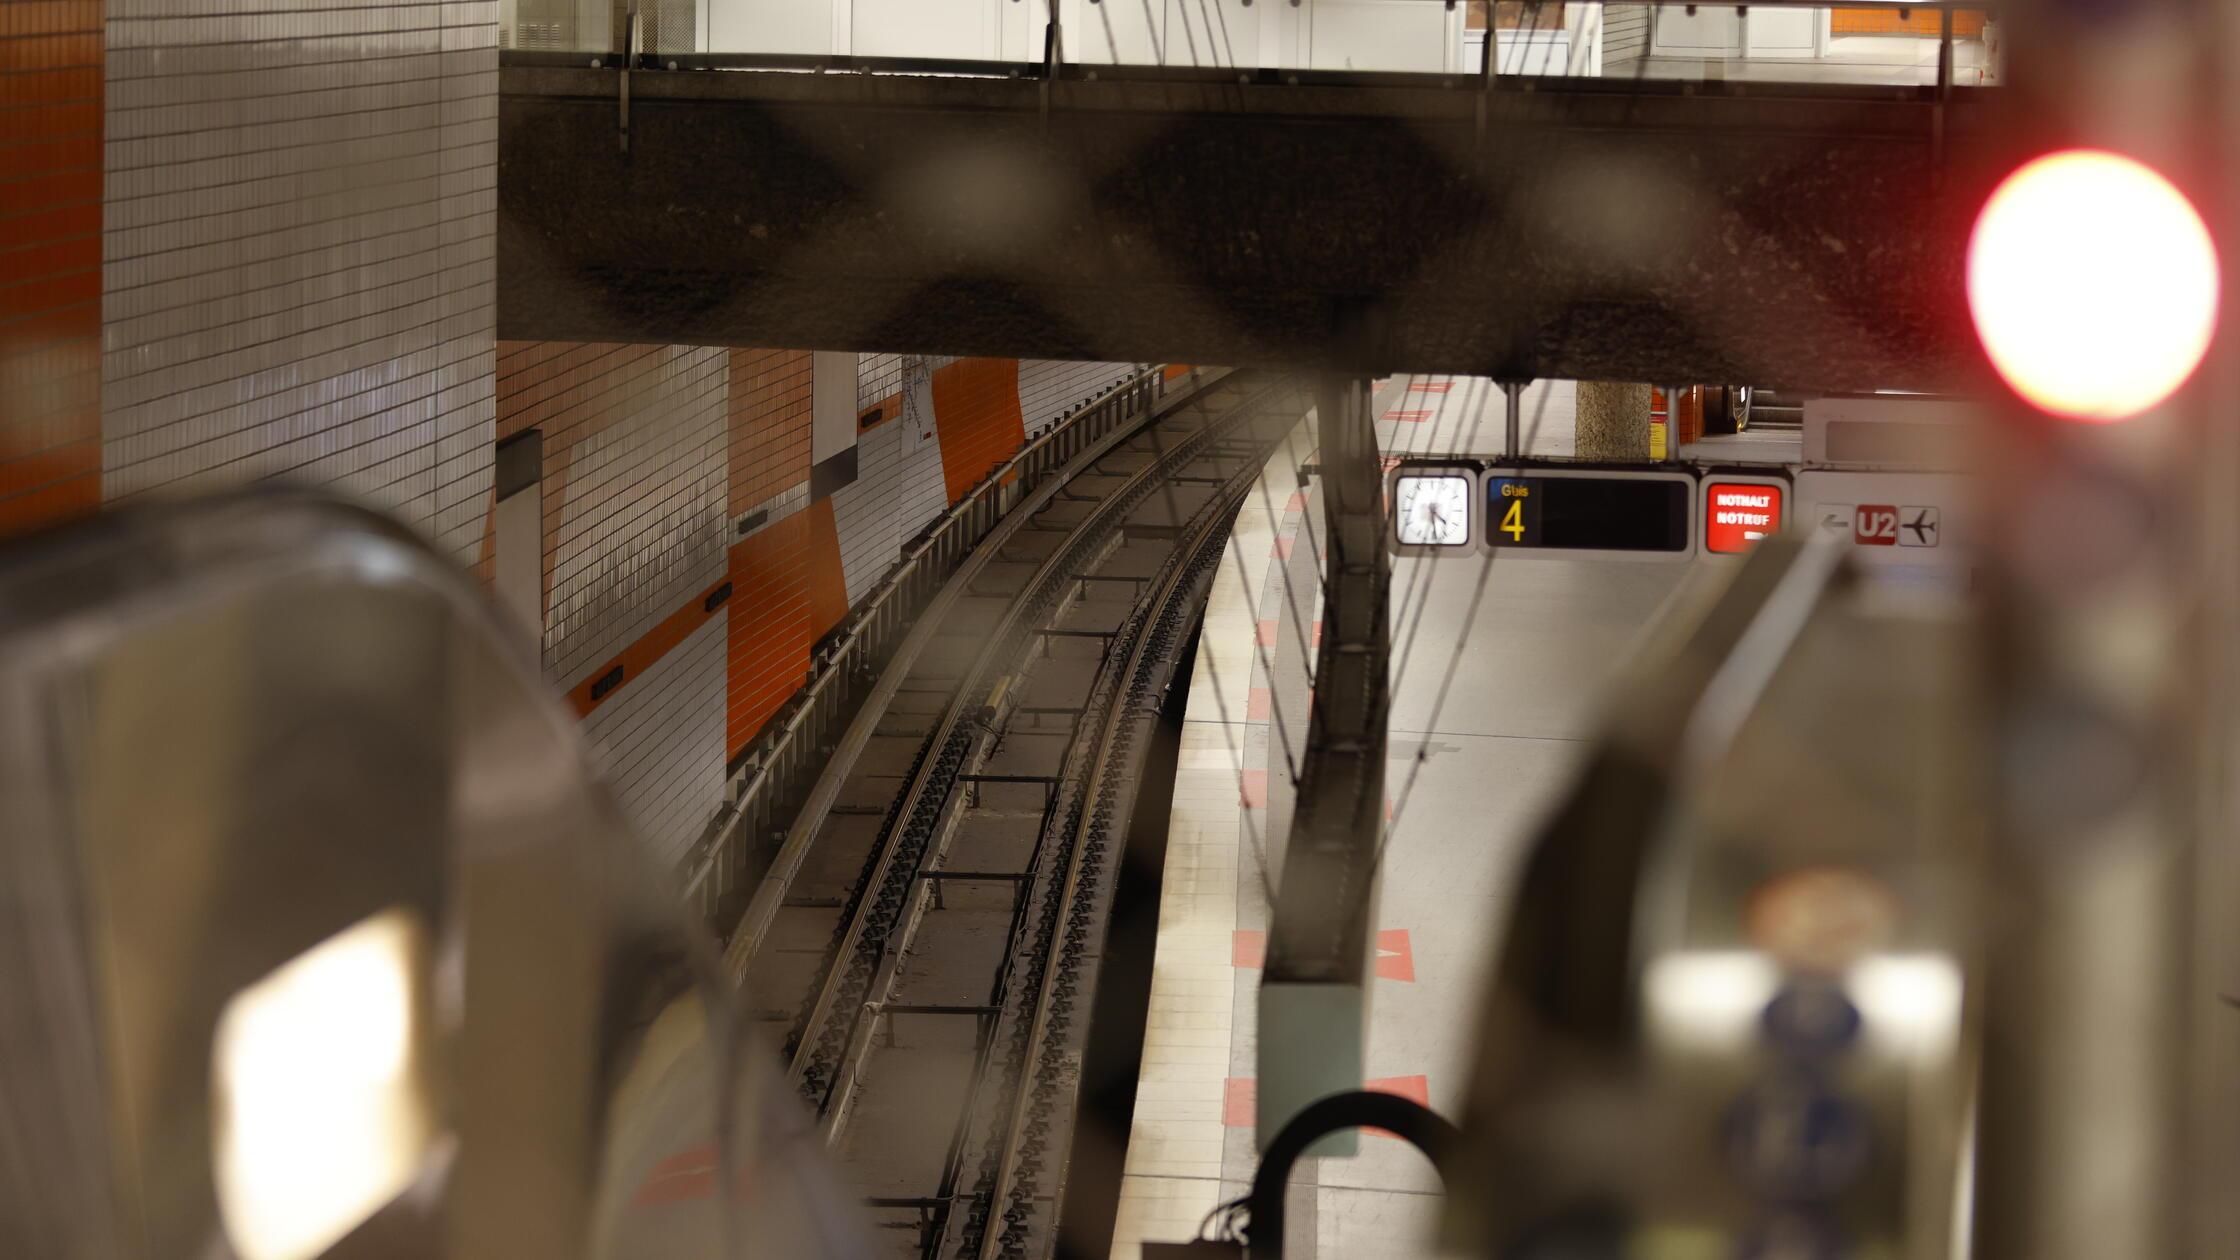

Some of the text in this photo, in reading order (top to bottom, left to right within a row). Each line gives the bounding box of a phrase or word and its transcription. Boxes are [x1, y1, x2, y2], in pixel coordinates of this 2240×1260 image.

[1717, 494, 1770, 508] NOTHALT
[1499, 499, 1526, 541] 4
[1716, 512, 1770, 527] NOTRUF
[1858, 512, 1896, 537] U2
